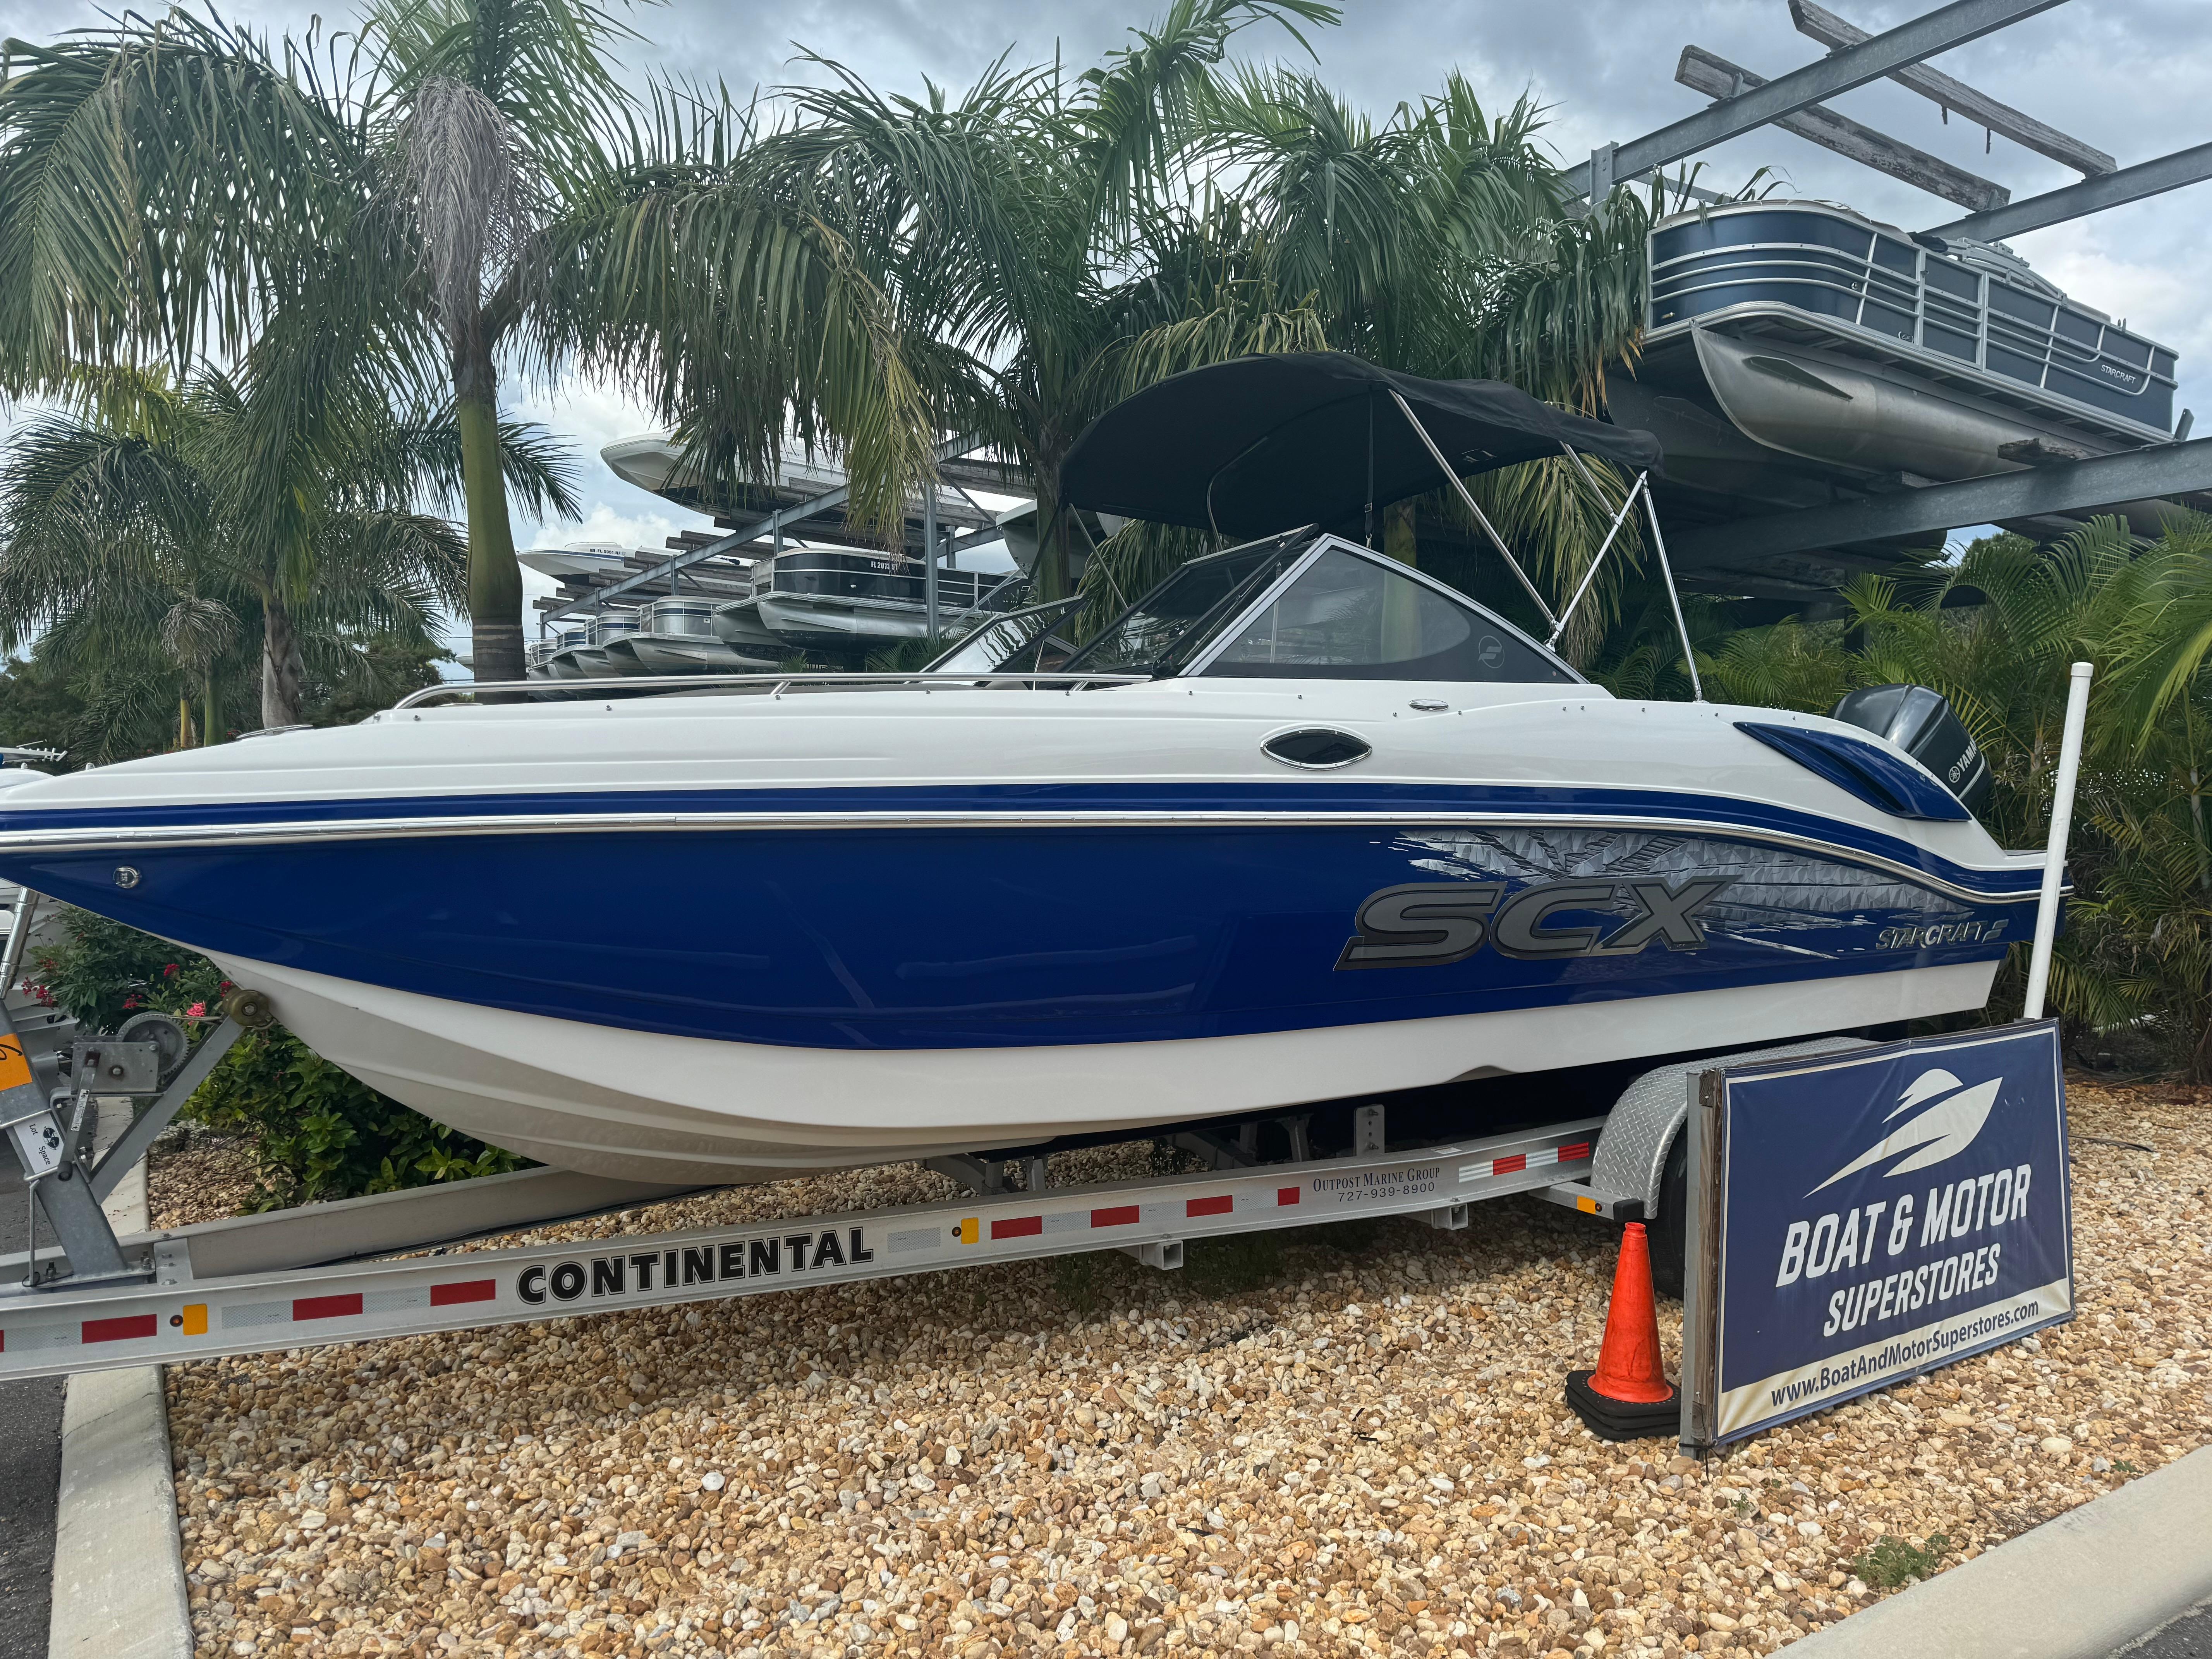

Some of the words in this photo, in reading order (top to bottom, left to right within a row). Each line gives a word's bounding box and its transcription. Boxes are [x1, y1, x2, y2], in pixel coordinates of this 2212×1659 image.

[2101, 364, 2136, 384] STARCRAFT
[1333, 874, 1743, 971] SCX
[1875, 921, 1989, 950] STARCRAFT
[29, 1123, 38, 1135] Lot
[38, 1146, 51, 1165] Space
[1313, 1176, 1360, 1192] OUTPOST
[1364, 1172, 1404, 1186] MARINE
[1407, 1167, 1440, 1181] GROUP
[1338, 1182, 1435, 1202] 727-939-8900
[1776, 1201, 1886, 1288] BOAT
[1888, 1194, 1914, 1256] &
[1920, 1164, 2032, 1247] MOTOR
[517, 1227, 874, 1305] CONTINENTAL
[1823, 1243, 2001, 1337] SUPERSTORES
[1771, 1299, 2039, 1407] www.BoatAndMotorSuperstores.com
